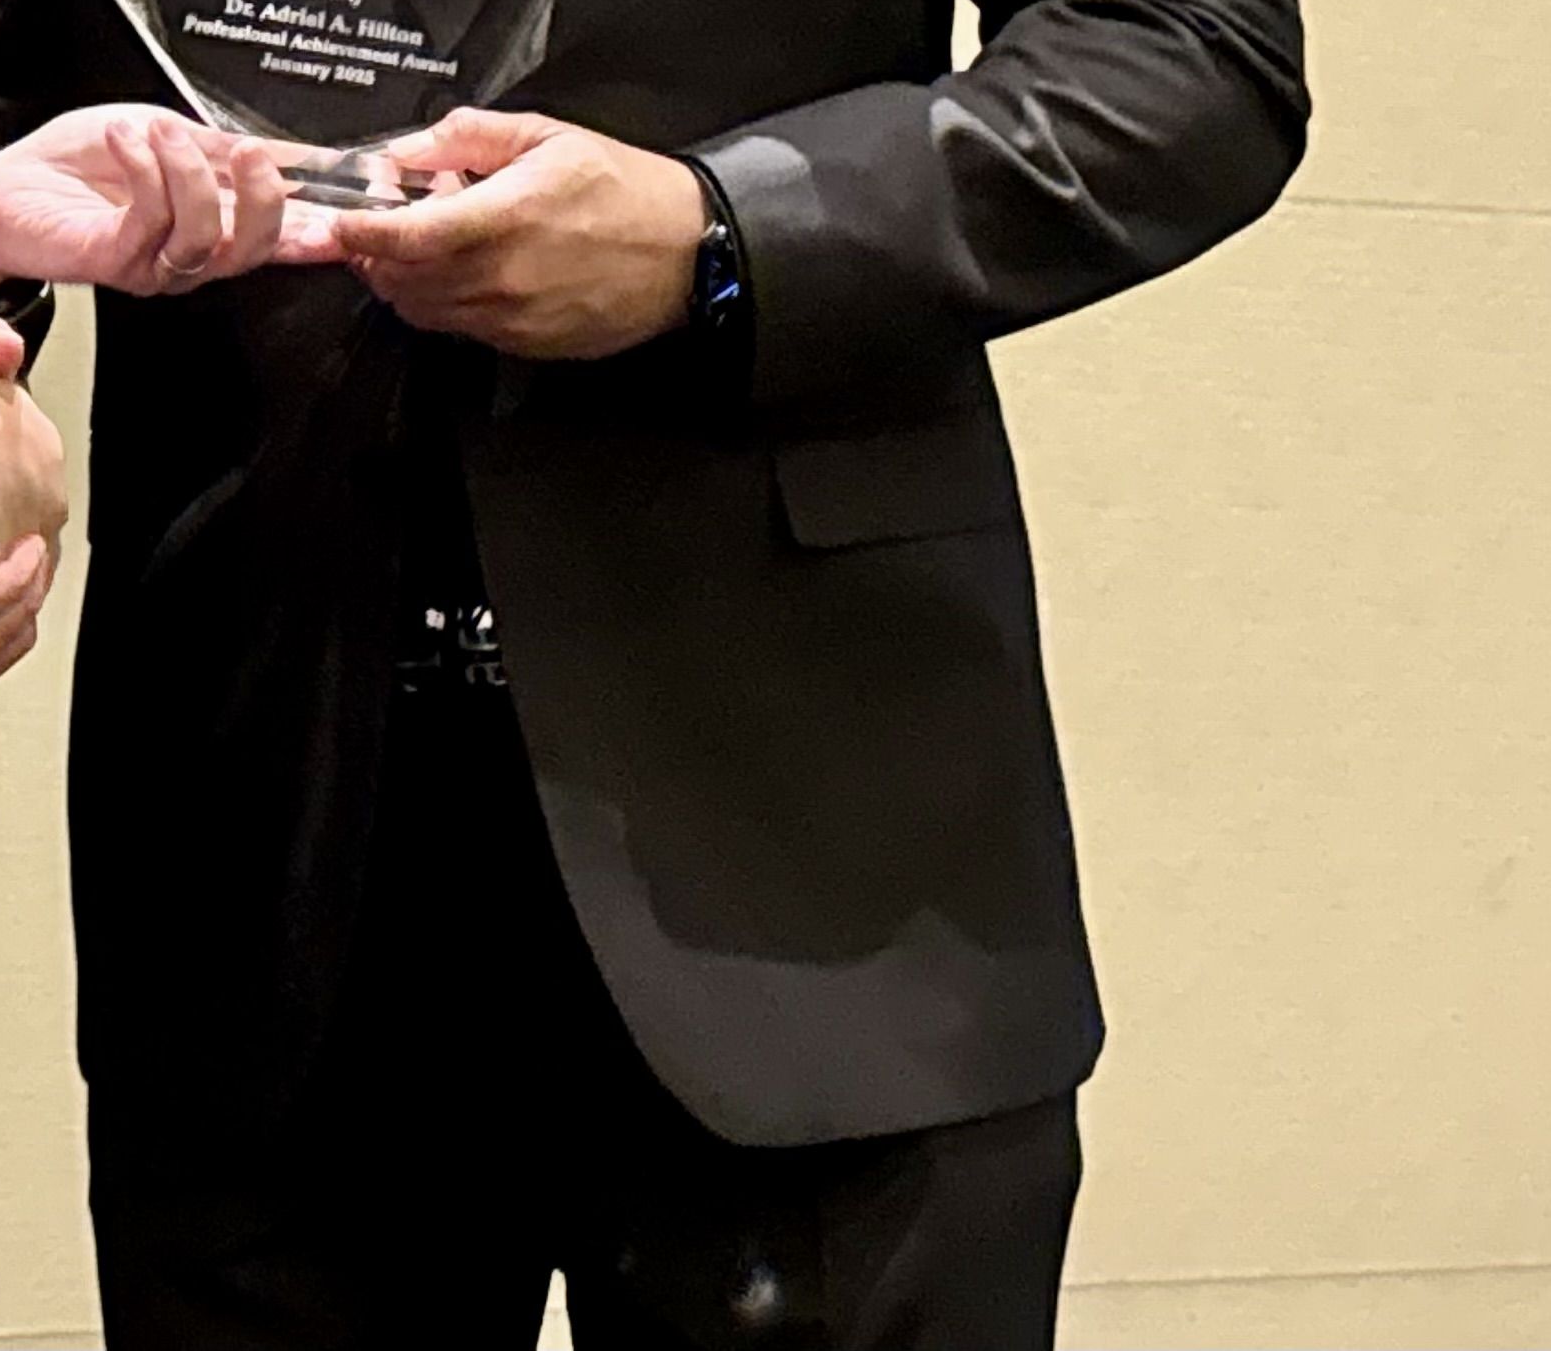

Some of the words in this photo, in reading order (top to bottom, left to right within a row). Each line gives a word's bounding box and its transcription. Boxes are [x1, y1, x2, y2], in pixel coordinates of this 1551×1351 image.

[182, 13, 289, 47] Professional
[289, 32, 400, 67] Achievement
[400, 52, 459, 78] Award
[328, 13, 352, 36] A.
[357, 18, 424, 47] Hilton
[259, 51, 332, 82] January
